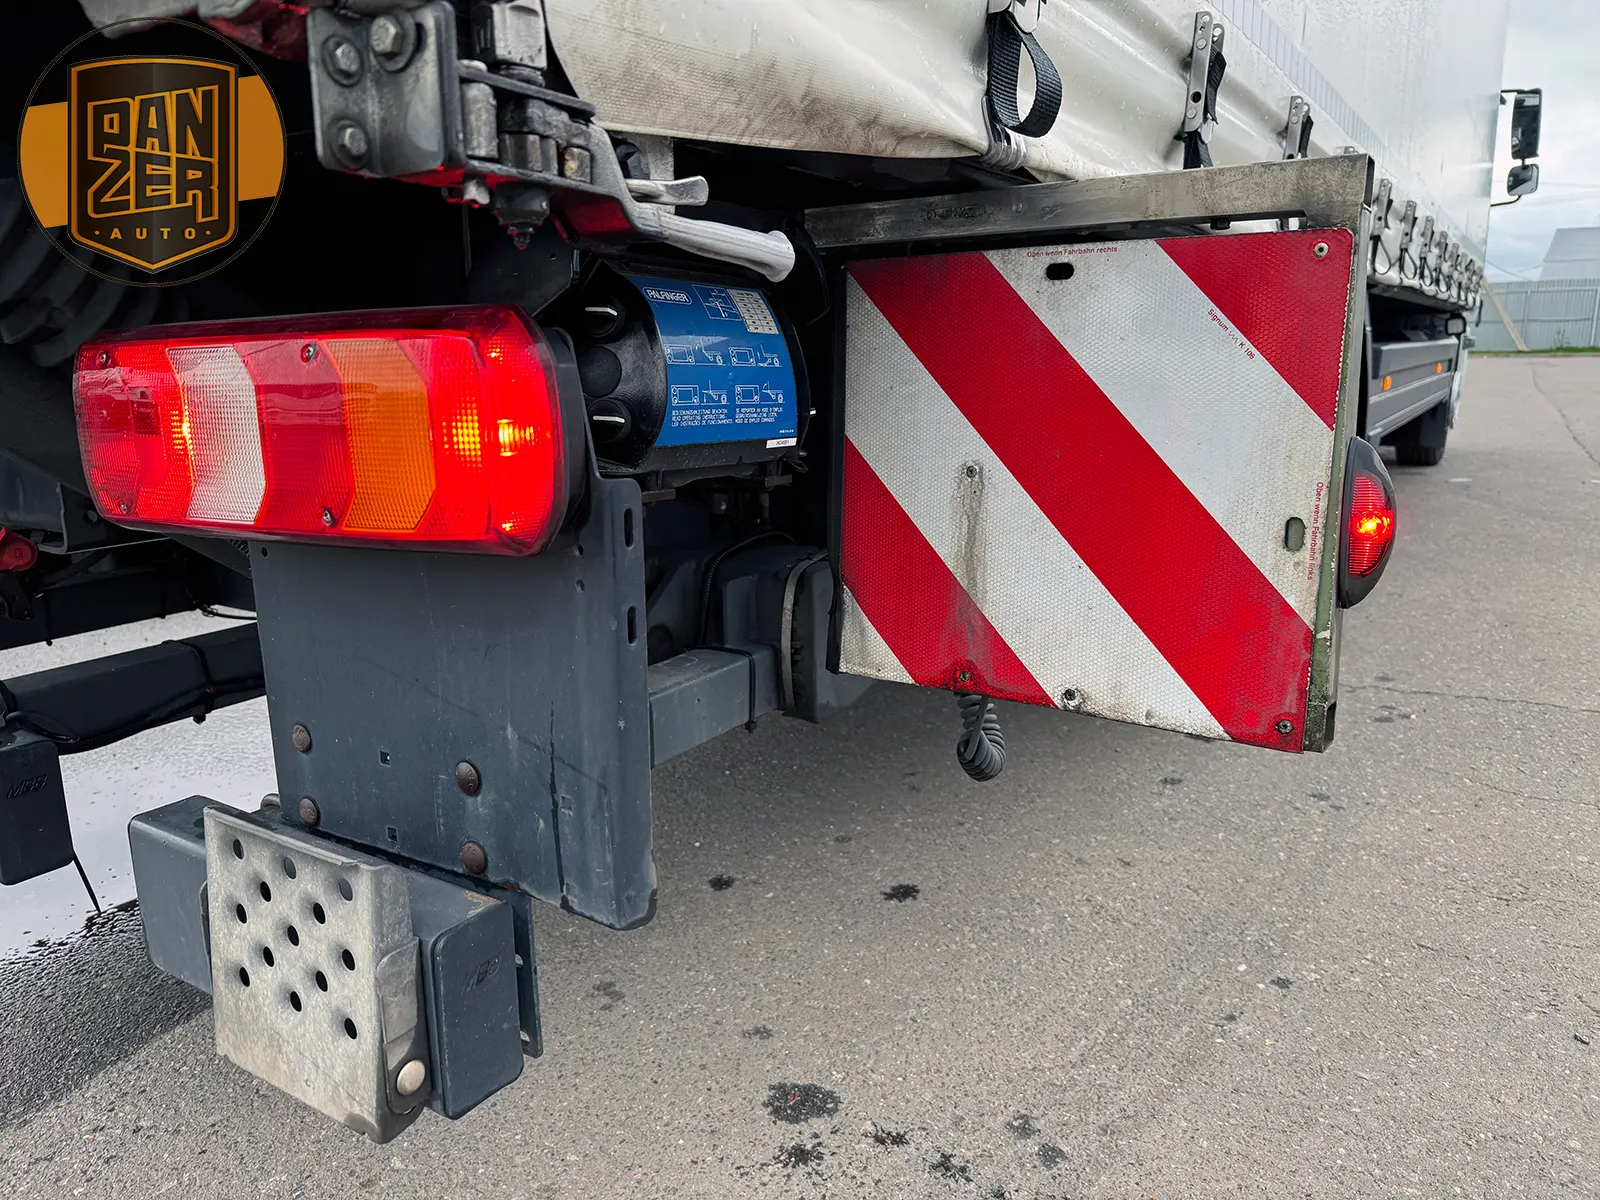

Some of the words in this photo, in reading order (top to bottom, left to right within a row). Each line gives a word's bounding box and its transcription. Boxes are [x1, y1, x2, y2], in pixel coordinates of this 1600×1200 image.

[1026, 250, 1044, 258] Oben
[1064, 247, 1095, 255] Fahrbahn
[646, 289, 689, 302] PALFINGER
[1207, 308, 1229, 332] Signum
[1238, 341, 1246, 349] K
[1244, 347, 1256, 360] 106
[1315, 481, 1324, 502] Oben
[1312, 503, 1321, 524] wenn
[1308, 526, 1320, 561] Fahrbahn
[1306, 562, 1317, 581] links
